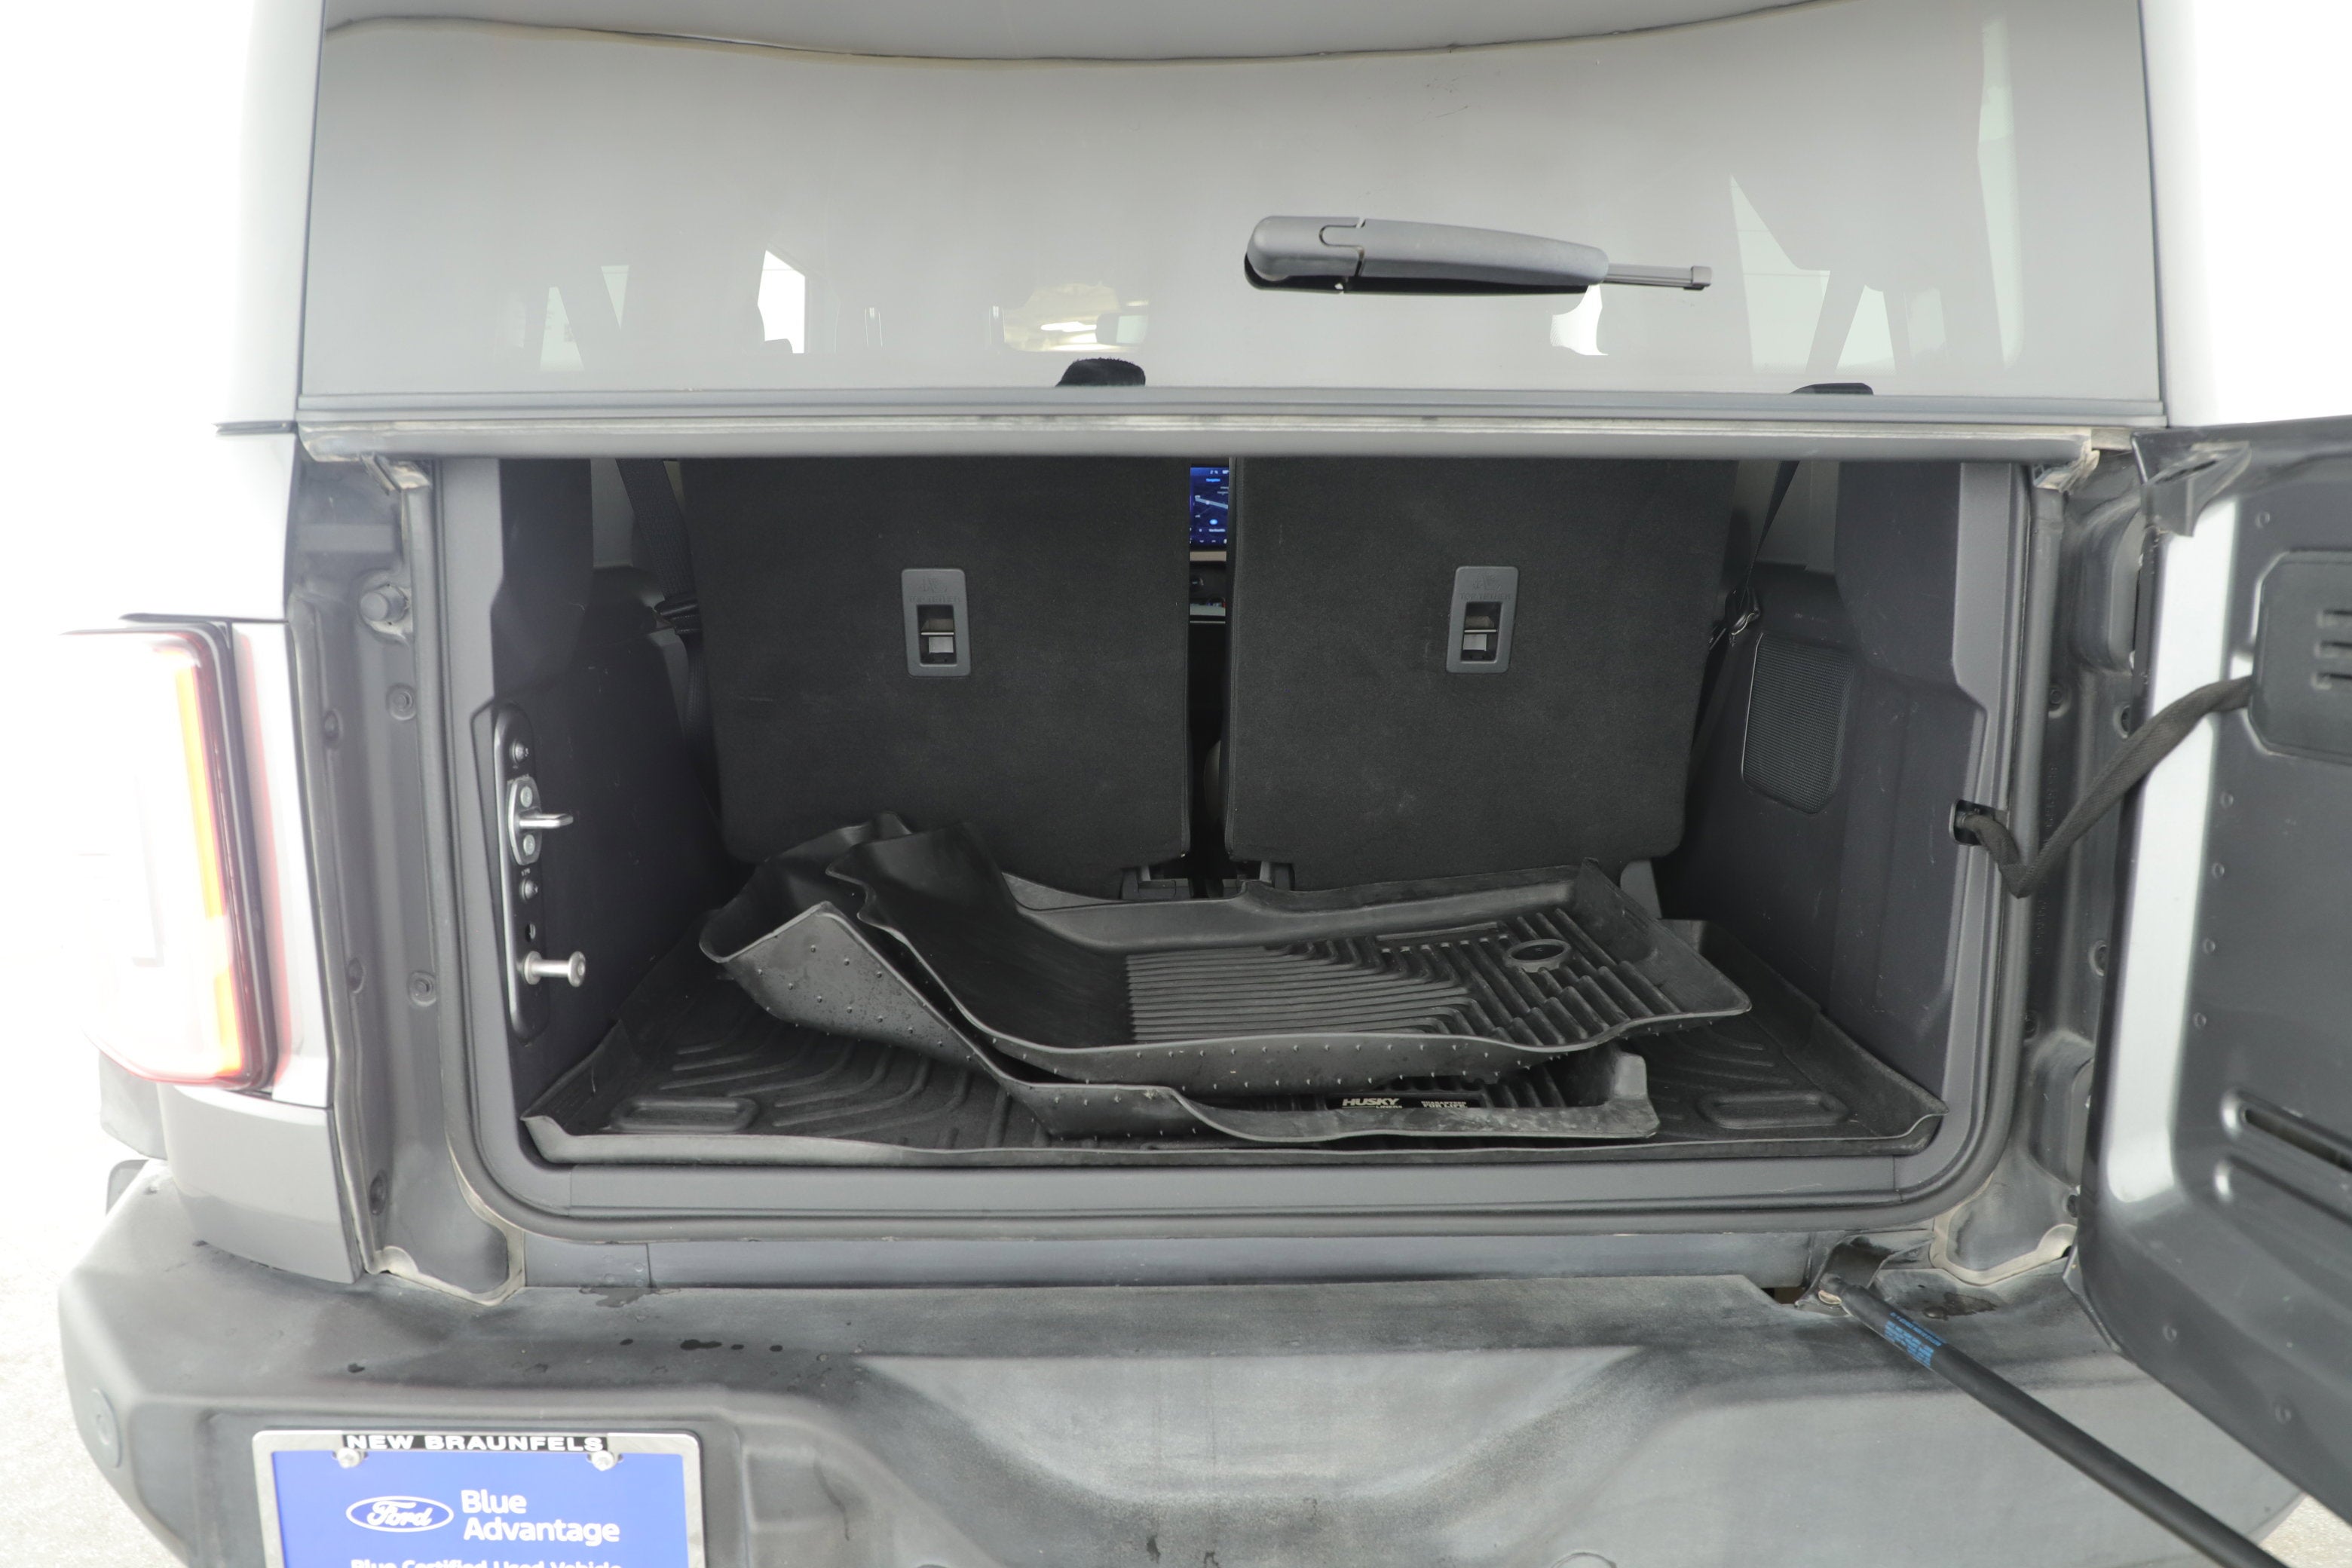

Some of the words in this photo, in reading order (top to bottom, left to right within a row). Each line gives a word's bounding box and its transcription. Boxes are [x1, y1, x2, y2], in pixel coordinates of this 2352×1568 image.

[1342, 1098, 1400, 1106] HUSKY
[346, 1435, 415, 1450] NEW
[424, 1435, 604, 1452] BRAUNFELS
[366, 1500, 433, 1527] Ford
[461, 1489, 527, 1514] Blue
[463, 1517, 620, 1547] Advantage
